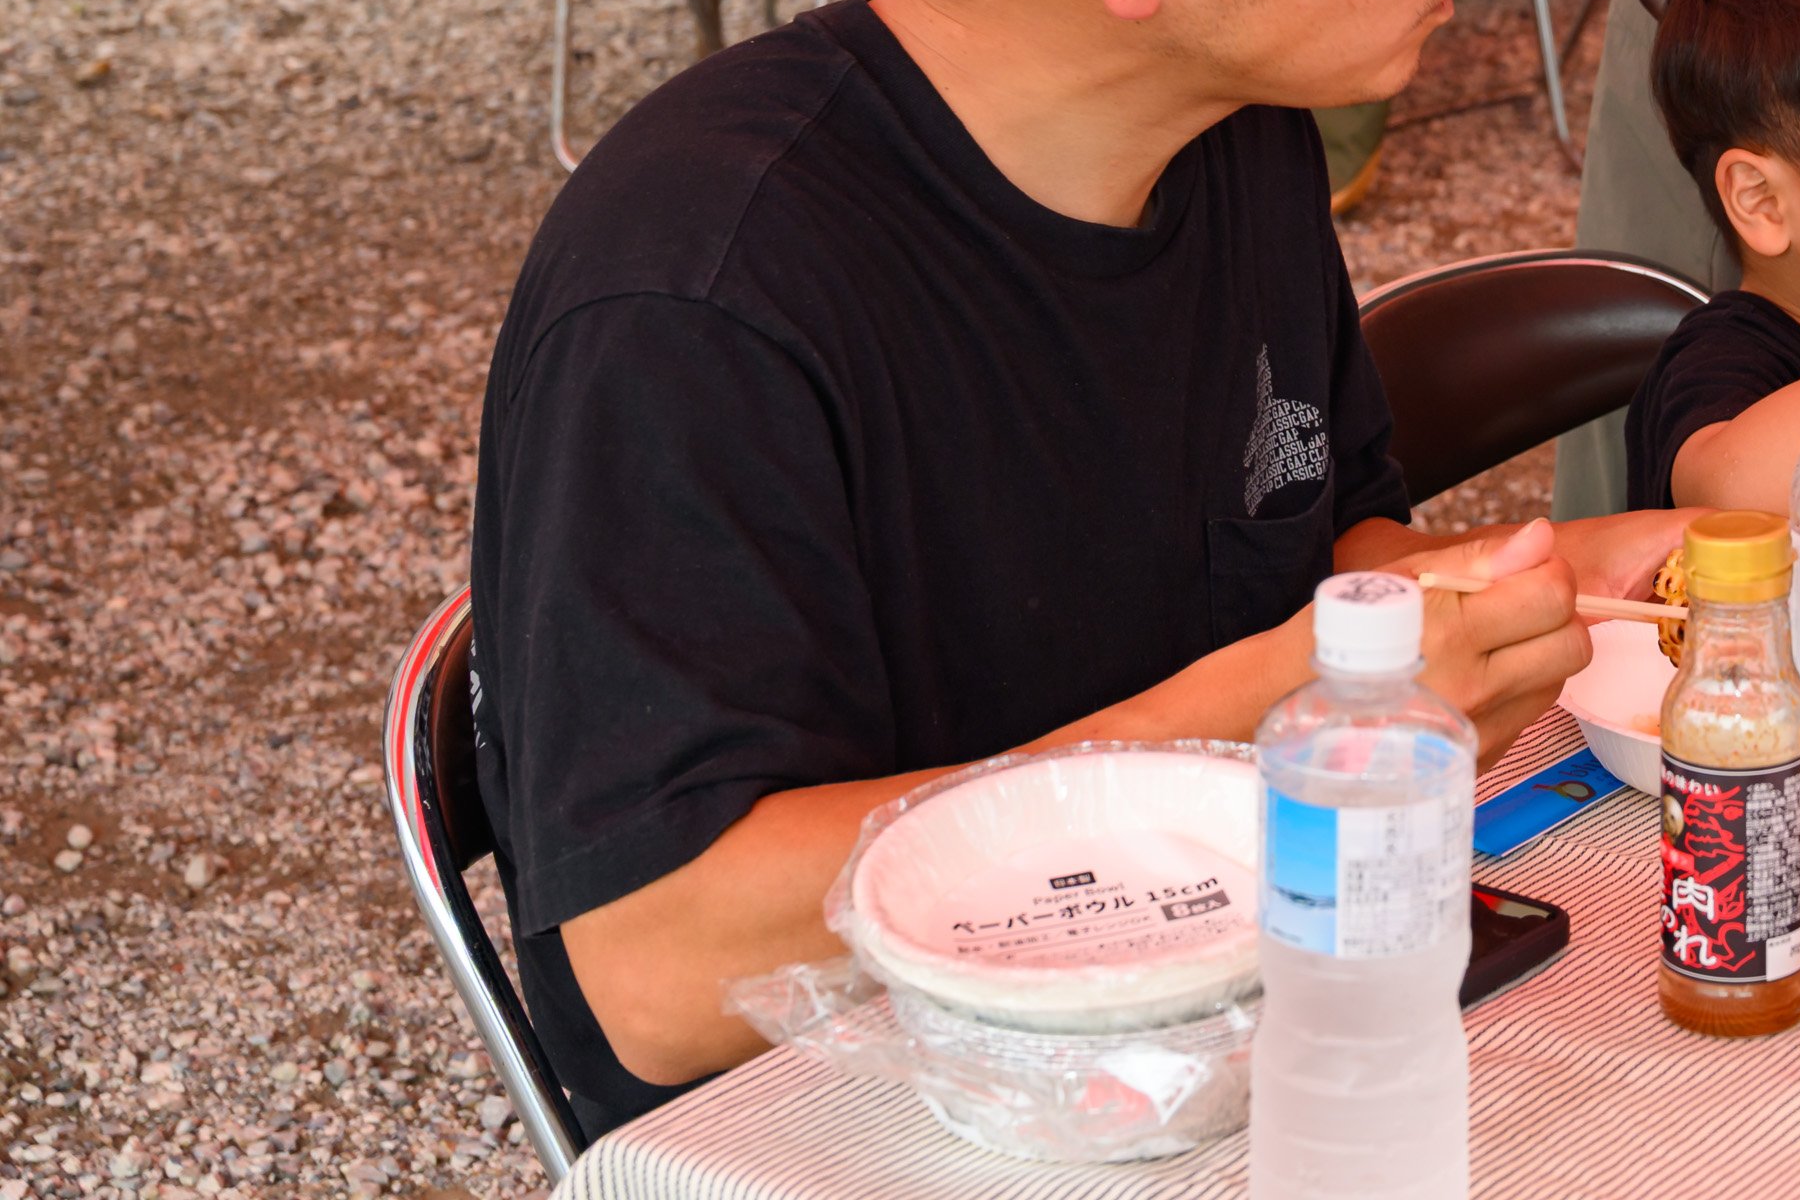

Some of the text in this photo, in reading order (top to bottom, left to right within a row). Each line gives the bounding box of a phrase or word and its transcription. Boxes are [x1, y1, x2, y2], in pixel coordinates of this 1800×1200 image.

[1272, 402, 1291, 418] GAP
[1299, 407, 1319, 423] GAP
[1278, 428, 1299, 445] GAP
[1287, 453, 1308, 470] GAP
[1032, 881, 1126, 906] Paper Bowl
[1146, 876, 1221, 903] 15cm
[1661, 876, 1716, 922] 肉
[1661, 923, 1718, 967] れ
